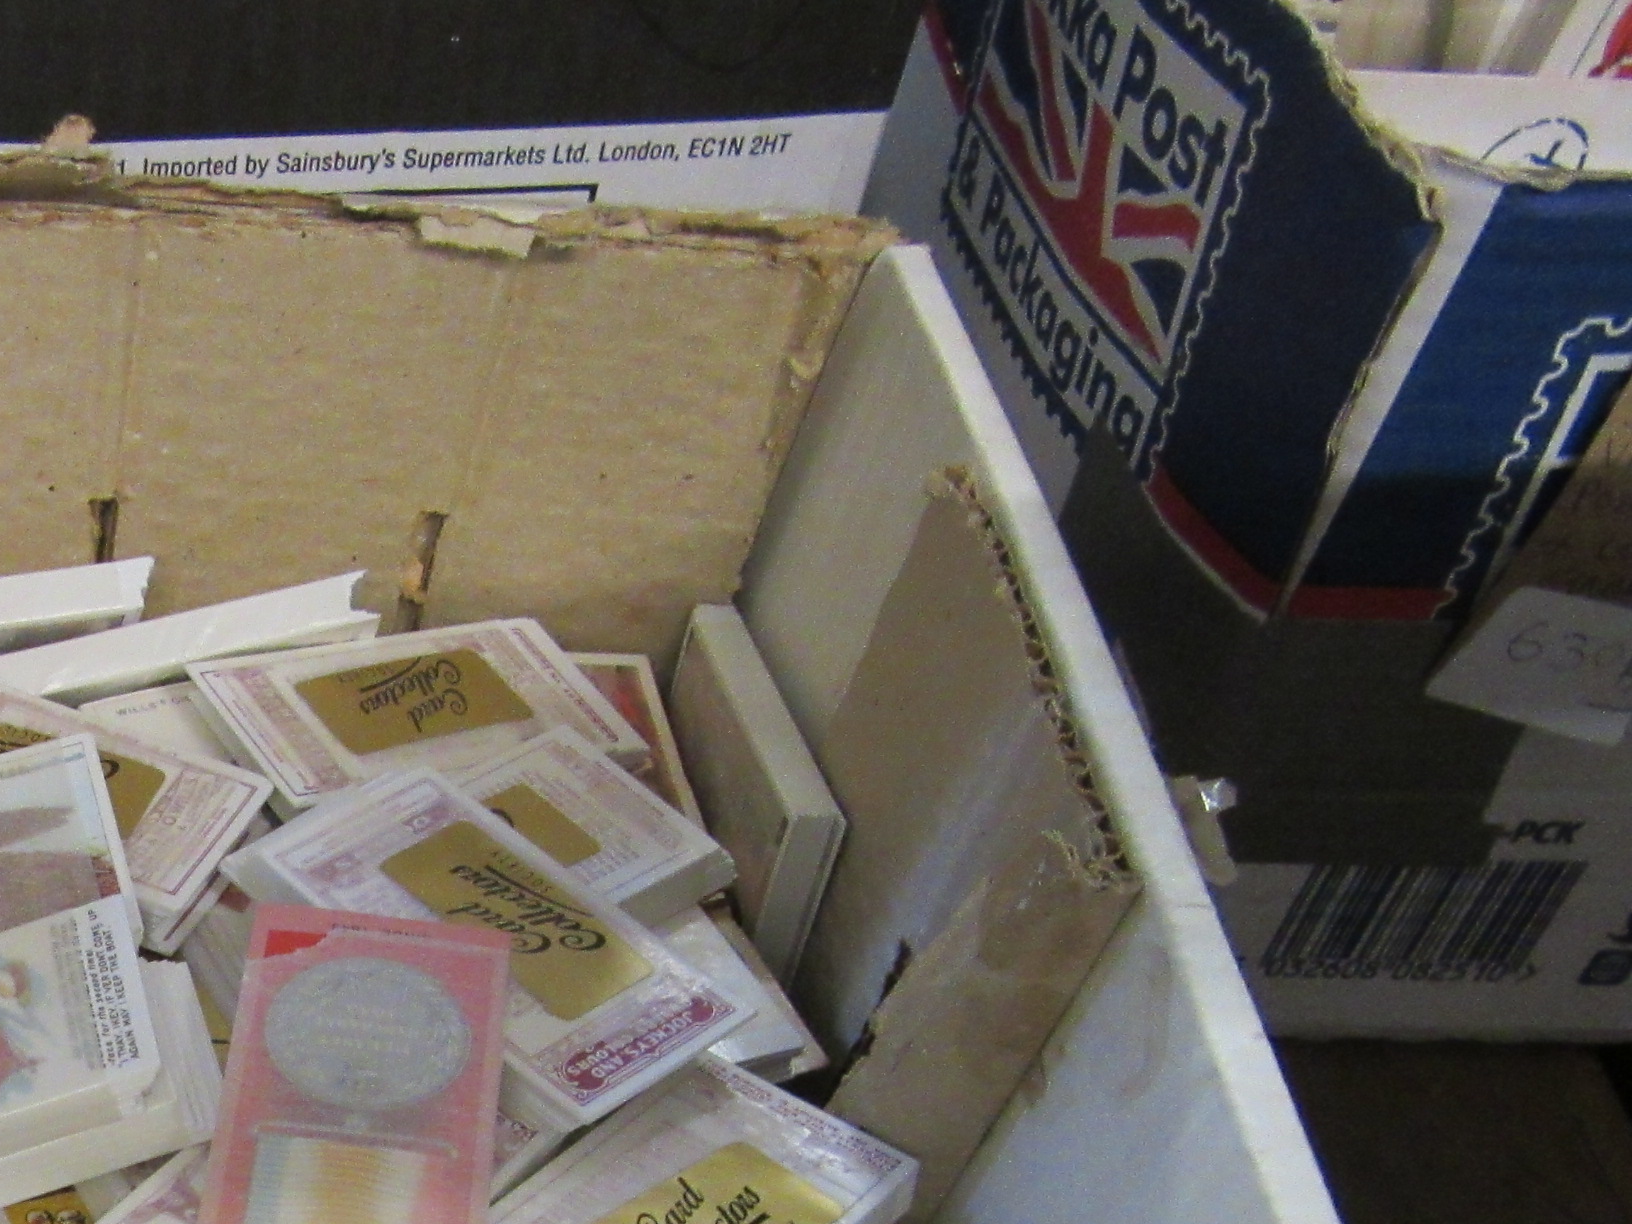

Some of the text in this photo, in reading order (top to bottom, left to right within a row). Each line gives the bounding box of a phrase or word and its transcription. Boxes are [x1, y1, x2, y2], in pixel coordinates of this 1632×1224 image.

[1113, 25, 1228, 204] Post
[143, 154, 238, 177] Imported
[243, 155, 268, 179] by
[276, 150, 396, 177] Sainsbury's
[403, 145, 546, 172] Supermarkets
[553, 143, 589, 166] Ltd.
[598, 139, 681, 165] London,
[687, 137, 743, 160] EC1N
[749, 134, 791, 156] 2HT
[980, 173, 1143, 454] Packaging
[358, 659, 462, 716] Collectors
[406, 685, 468, 733] Card
[449, 863, 607, 952] Collectors
[124, 1030, 139, 1059] AGAIN
[589, 1012, 695, 1080] JOCKEYS AND
